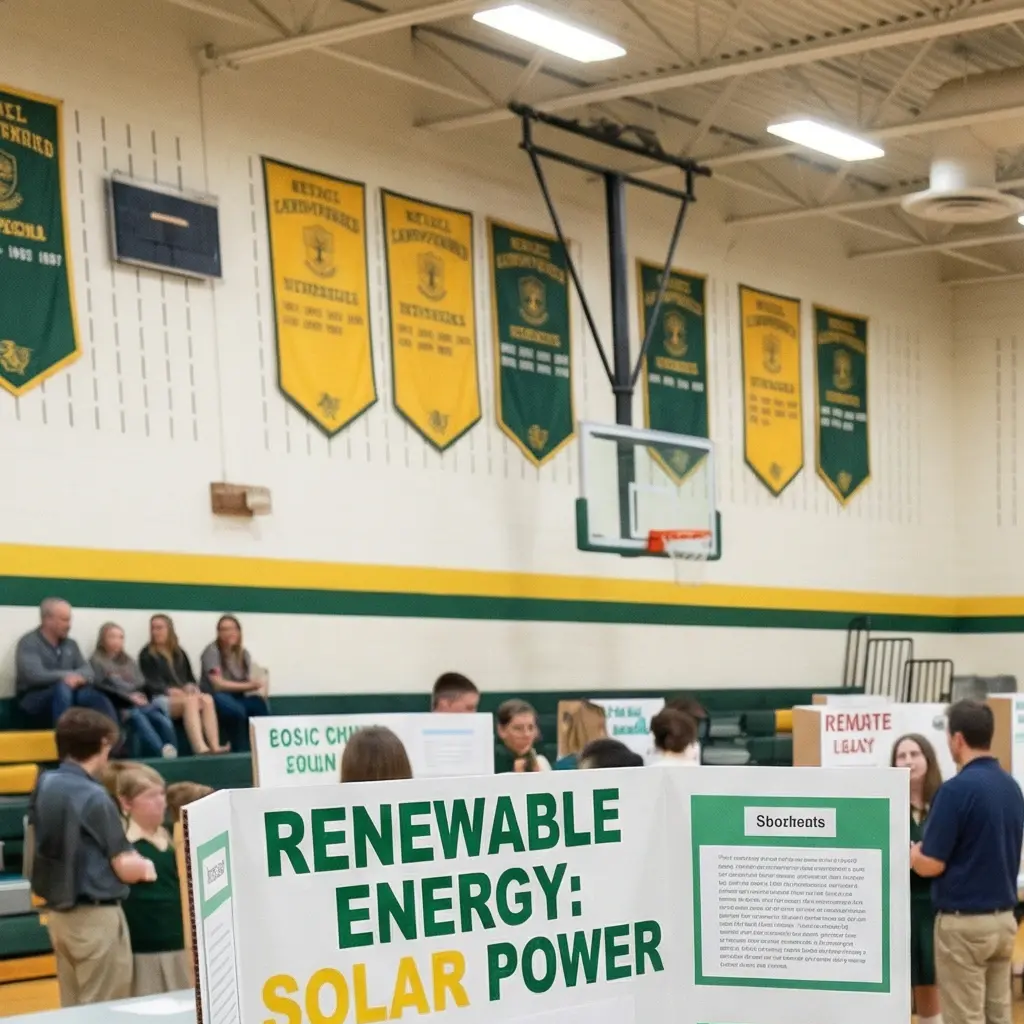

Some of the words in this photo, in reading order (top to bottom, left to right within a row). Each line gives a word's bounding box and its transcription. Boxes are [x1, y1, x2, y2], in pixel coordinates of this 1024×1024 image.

[264, 788, 622, 877] RENEWABLE
[336, 863, 582, 949] ENERGY:
[487, 920, 665, 1001] POWER
